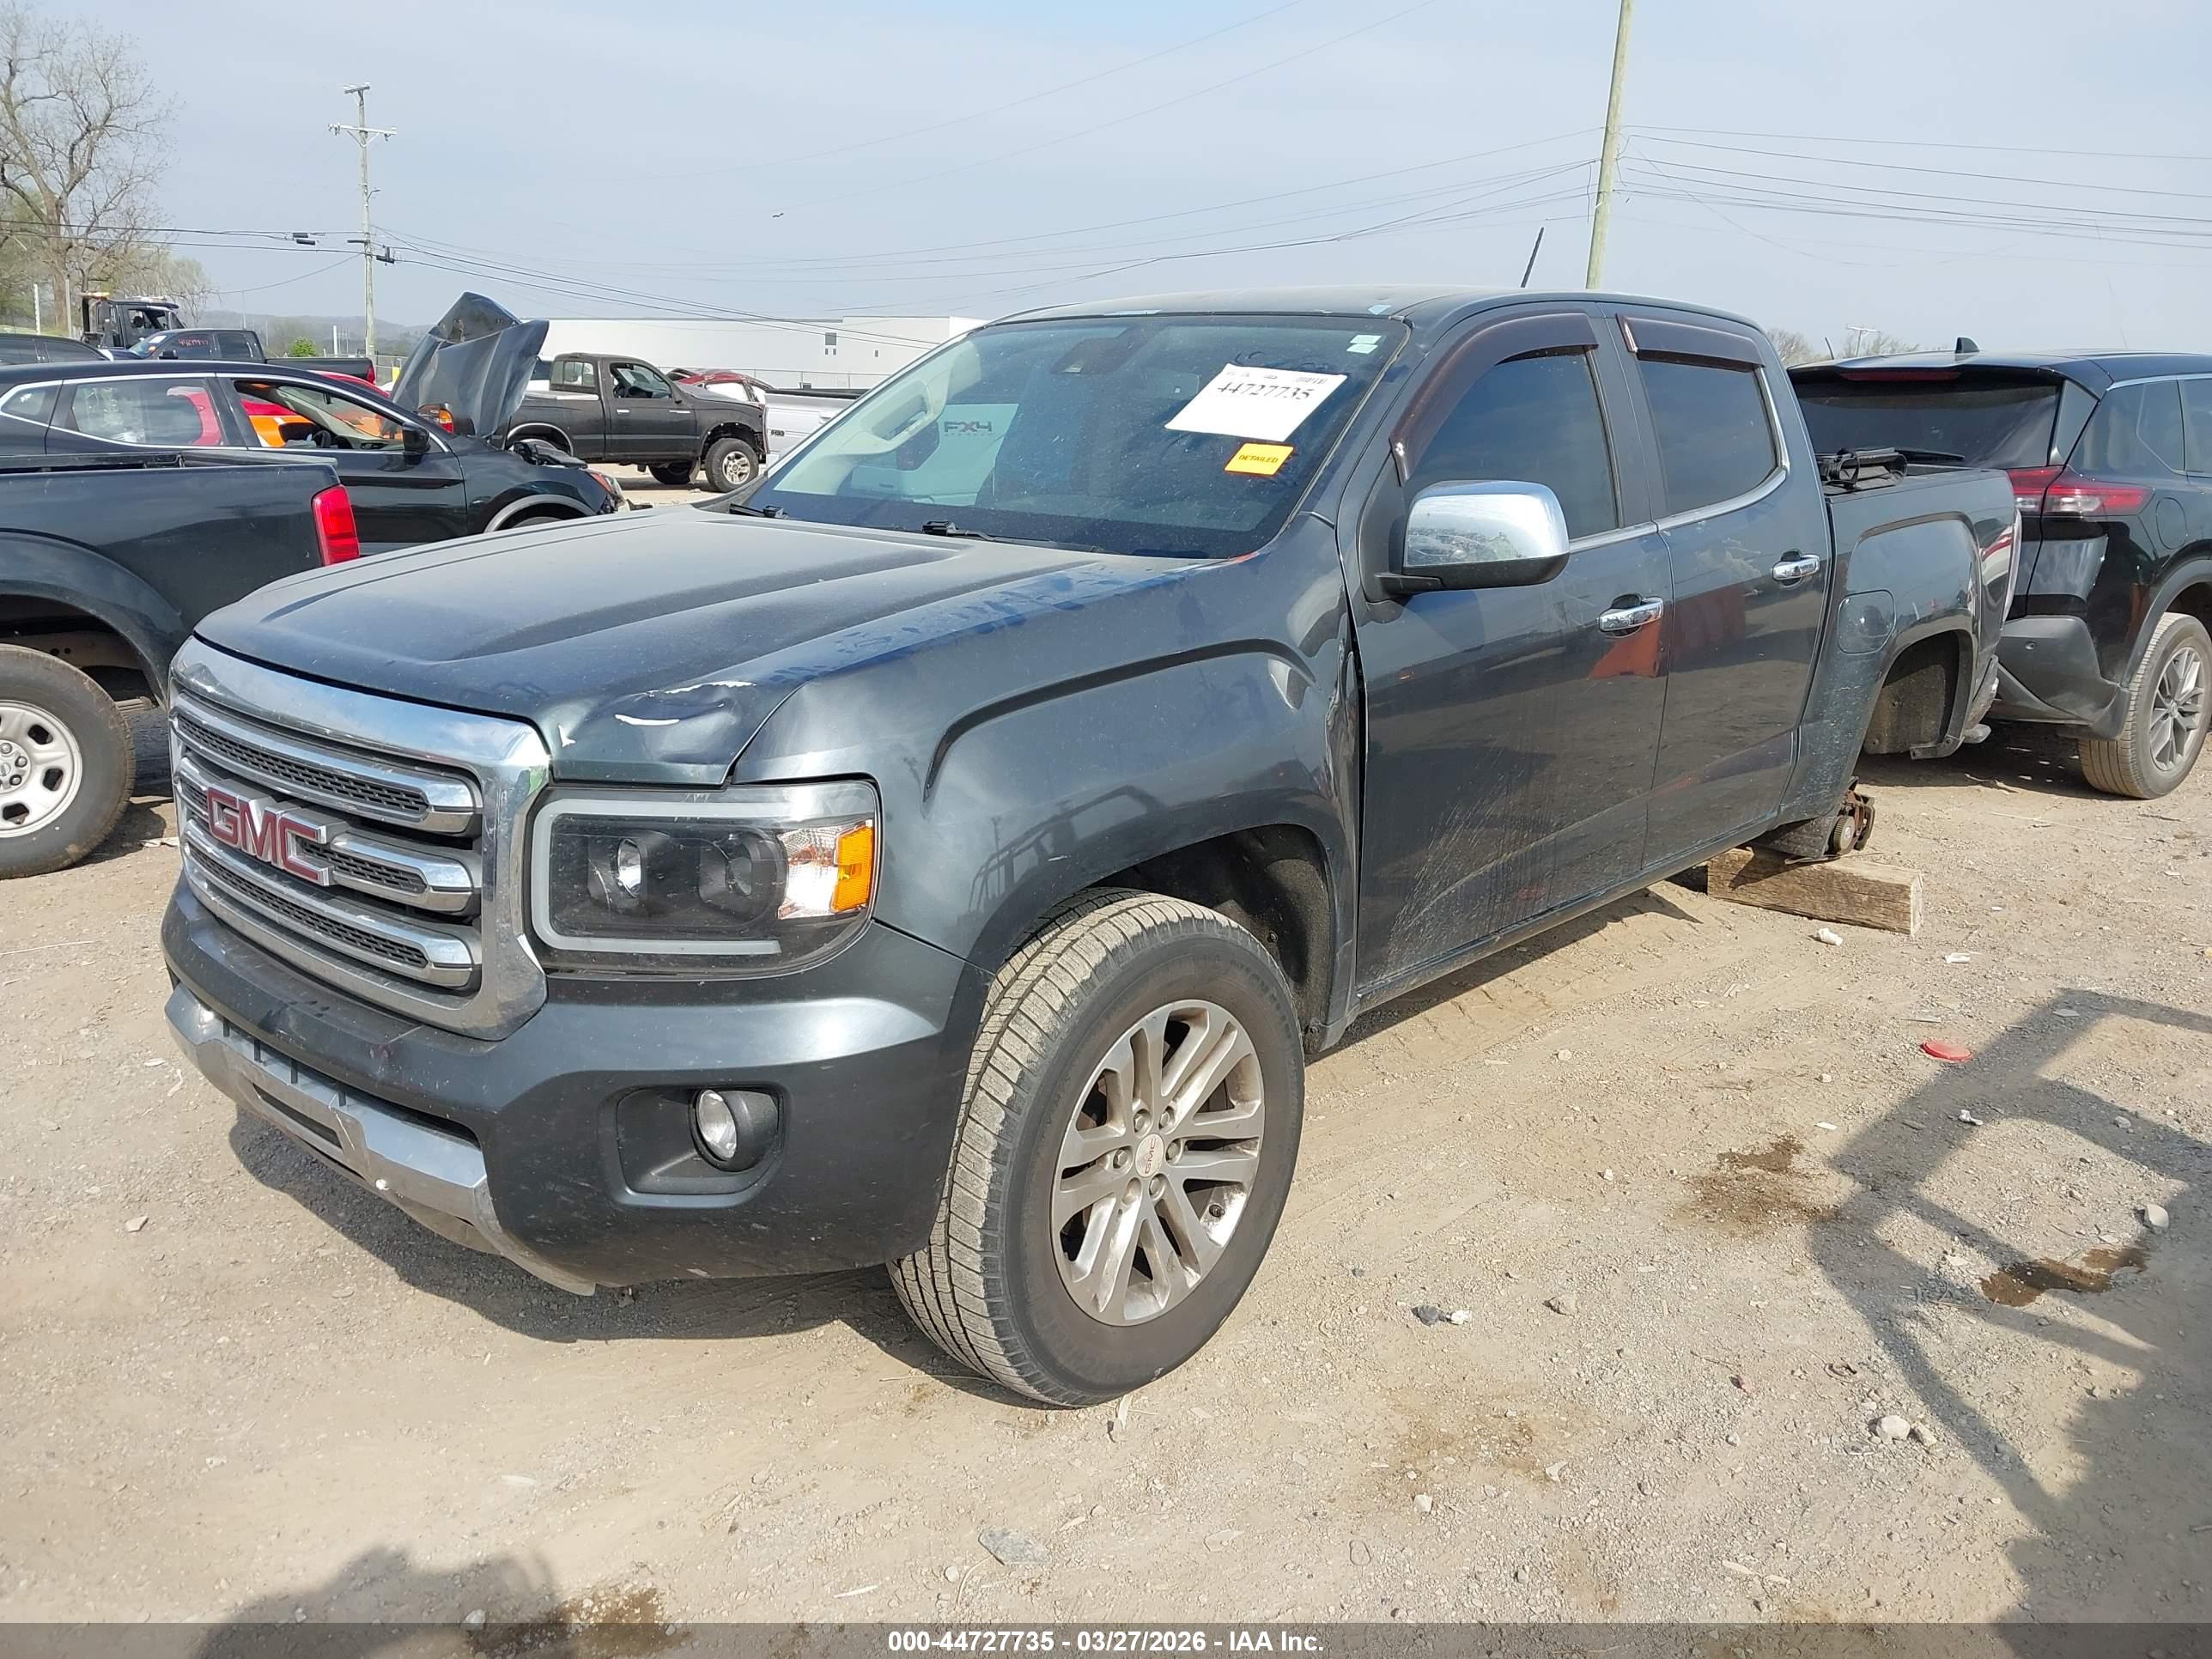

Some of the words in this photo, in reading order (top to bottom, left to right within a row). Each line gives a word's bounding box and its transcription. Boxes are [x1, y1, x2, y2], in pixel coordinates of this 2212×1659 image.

[1217, 381, 1316, 400] 44727735
[943, 421, 993, 433] FX4
[1238, 454, 1279, 464] DETAILED
[205, 782, 335, 886] GMC
[1144, 1137, 1157, 1175] GMC
